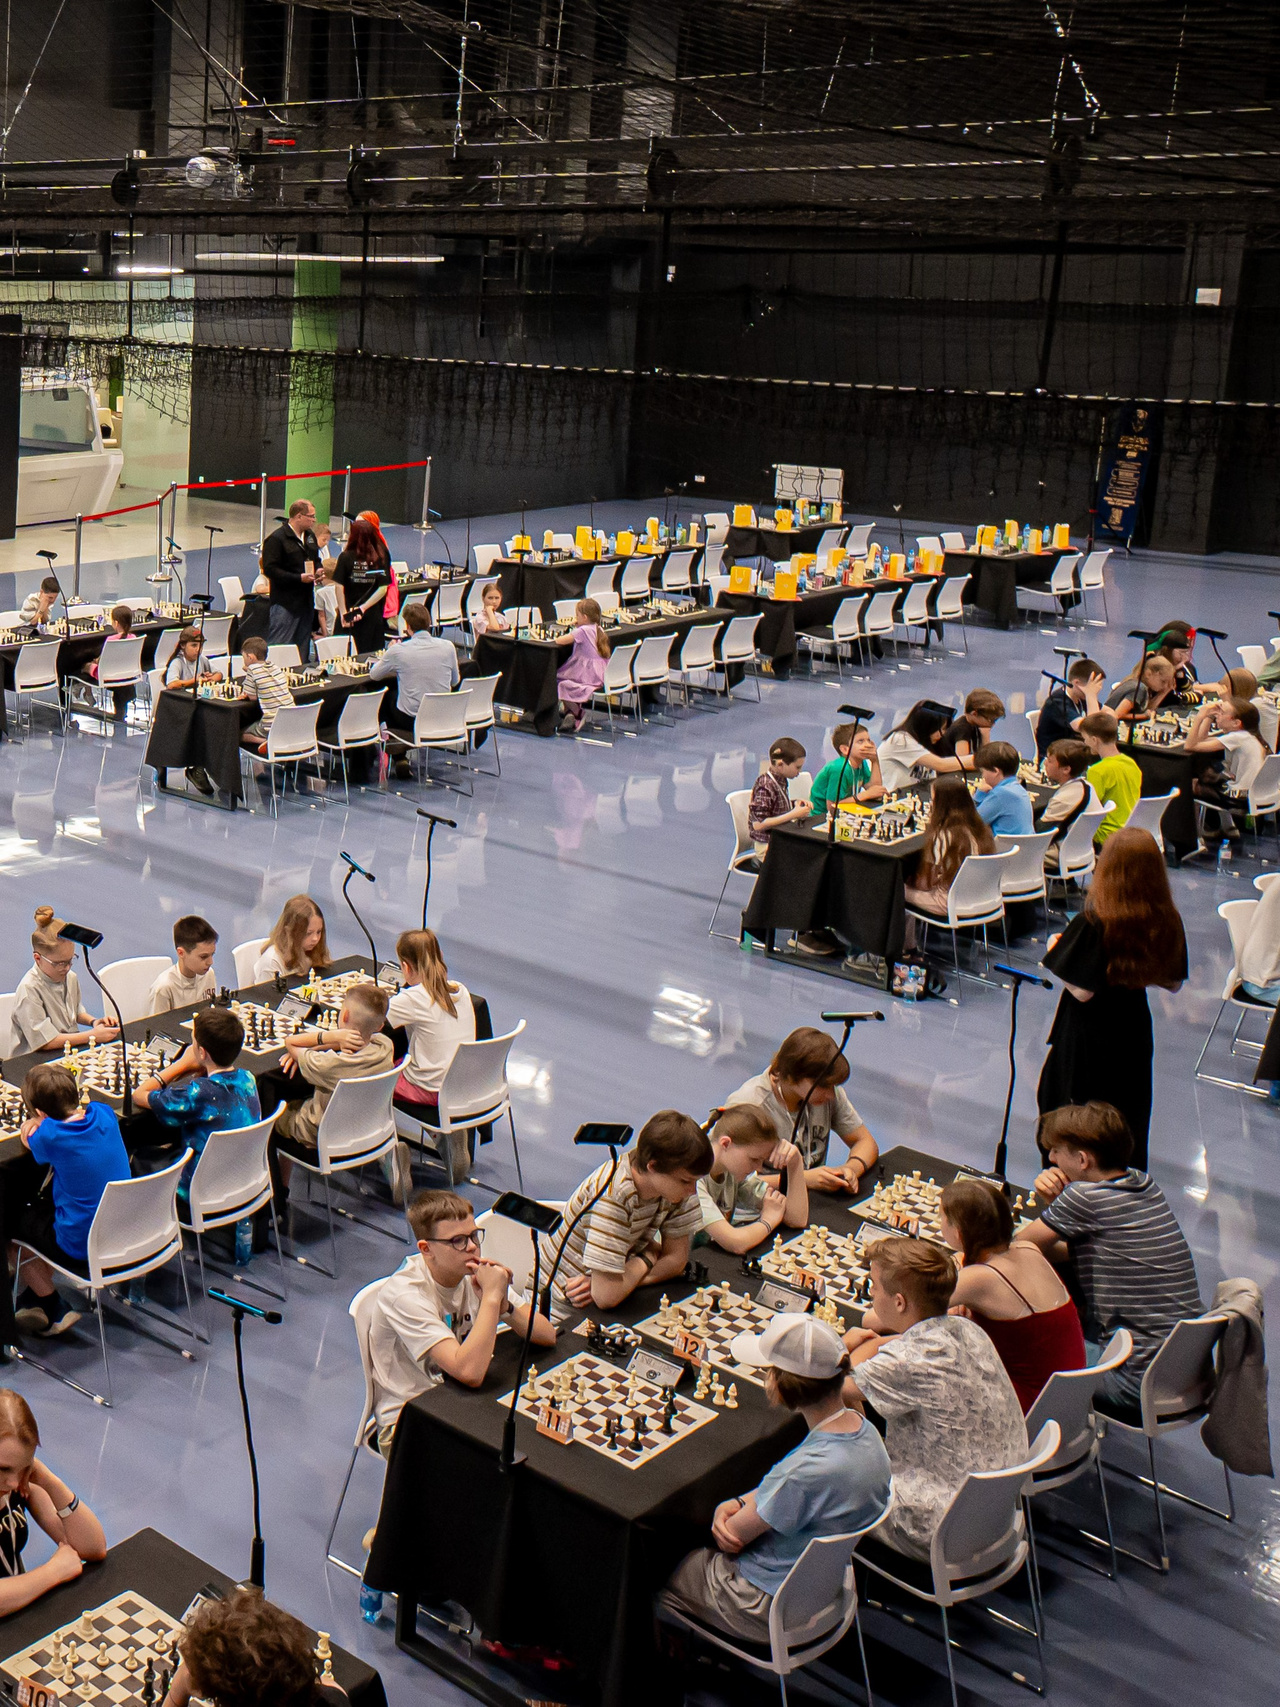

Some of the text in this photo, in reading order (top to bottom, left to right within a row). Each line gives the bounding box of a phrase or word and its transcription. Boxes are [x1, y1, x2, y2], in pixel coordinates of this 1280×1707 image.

[840, 827, 850, 837] 15
[895, 1215, 910, 1232] 14
[801, 1273, 816, 1290] 13
[683, 1336, 699, 1358] 12
[546, 1410, 561, 1432] 11
[28, 1684, 49, 1707] 10
